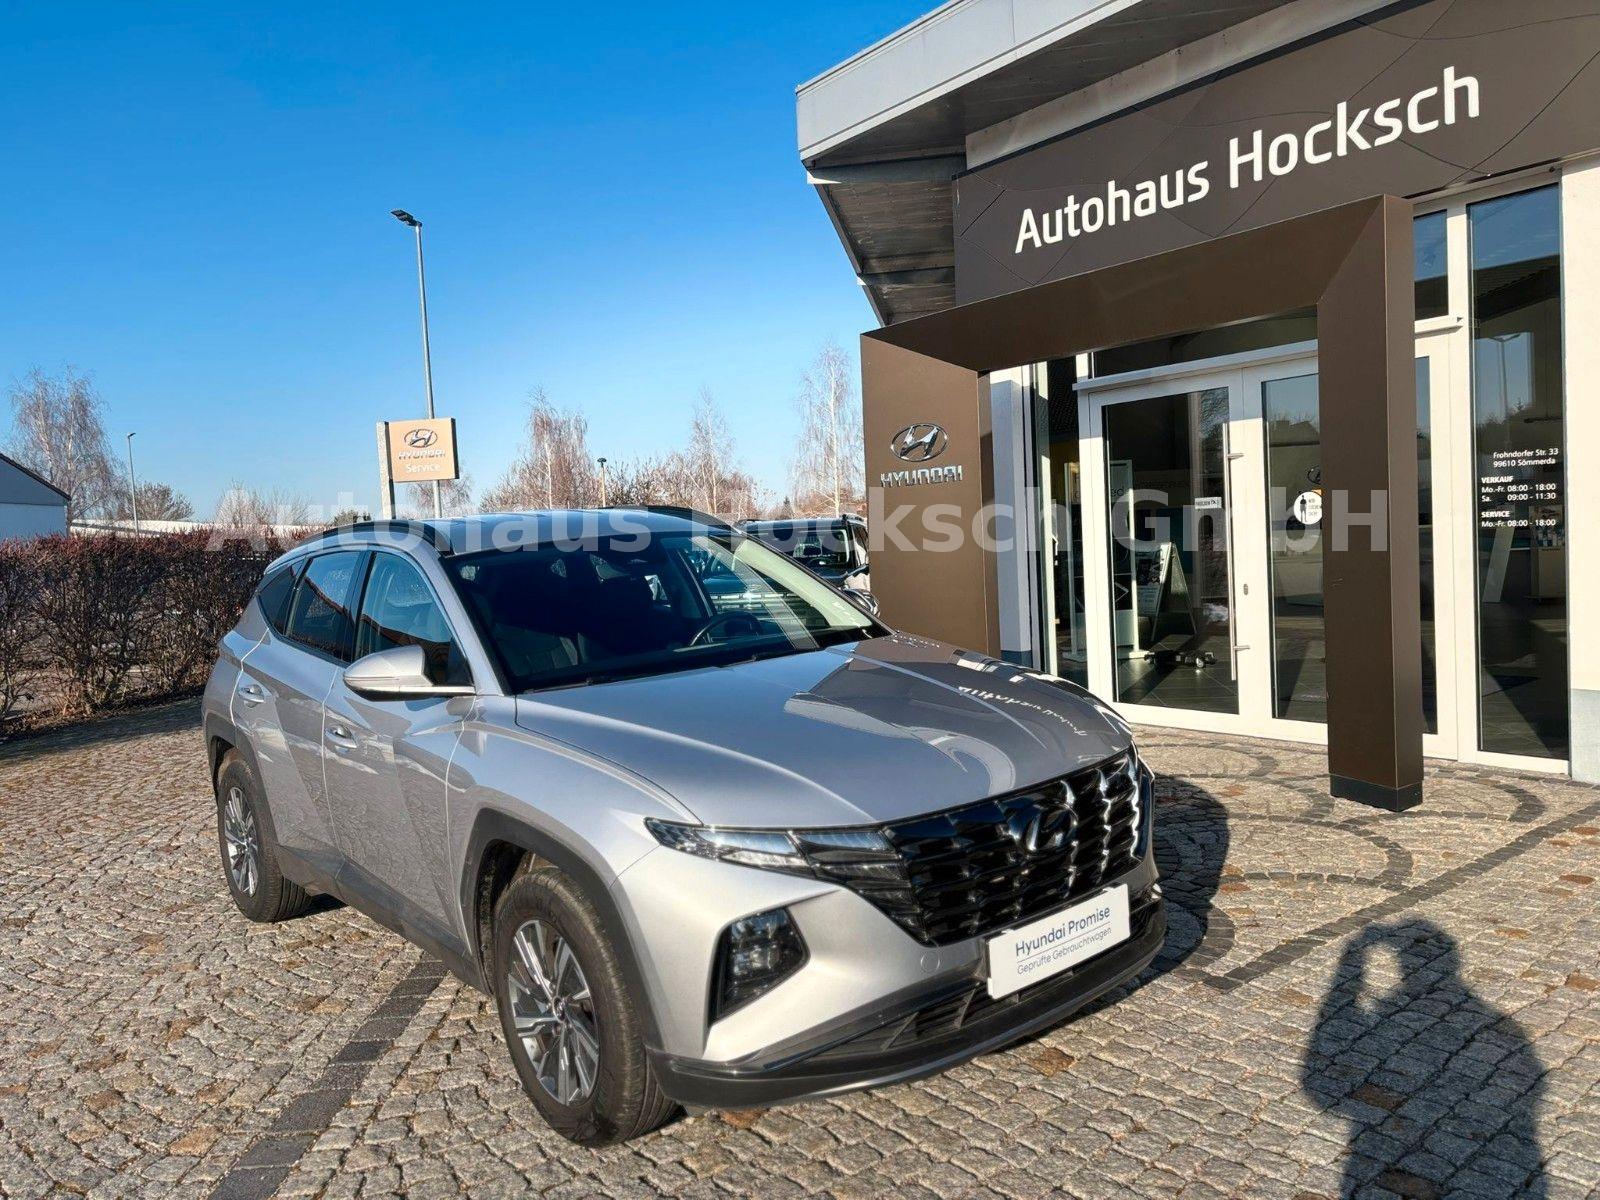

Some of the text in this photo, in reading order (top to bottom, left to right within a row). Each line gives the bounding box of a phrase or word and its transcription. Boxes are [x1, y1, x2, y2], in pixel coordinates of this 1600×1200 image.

[1014, 66, 1480, 254] Autohaus Hocksch
[1493, 450, 1534, 458] Frohndorfer
[1493, 457, 1556, 468] 99610 Sömmerda
[405, 463, 441, 473] Service
[881, 465, 963, 487] HYUNDAI
[1481, 485, 1506, 493] Mo.-Fr.
[1507, 484, 1529, 492] 08:00
[1535, 483, 1556, 491] 18:00
[1507, 493, 1529, 501] 09:00
[1535, 492, 1556, 500] 11:30
[1481, 510, 1511, 518] SERVICE
[1507, 519, 1529, 527] 08:00
[1535, 518, 1556, 526] 18:00
[1015, 907, 1110, 957] Hyundai Promise
[1052, 927, 1112, 960] Gebrauchtwagen
